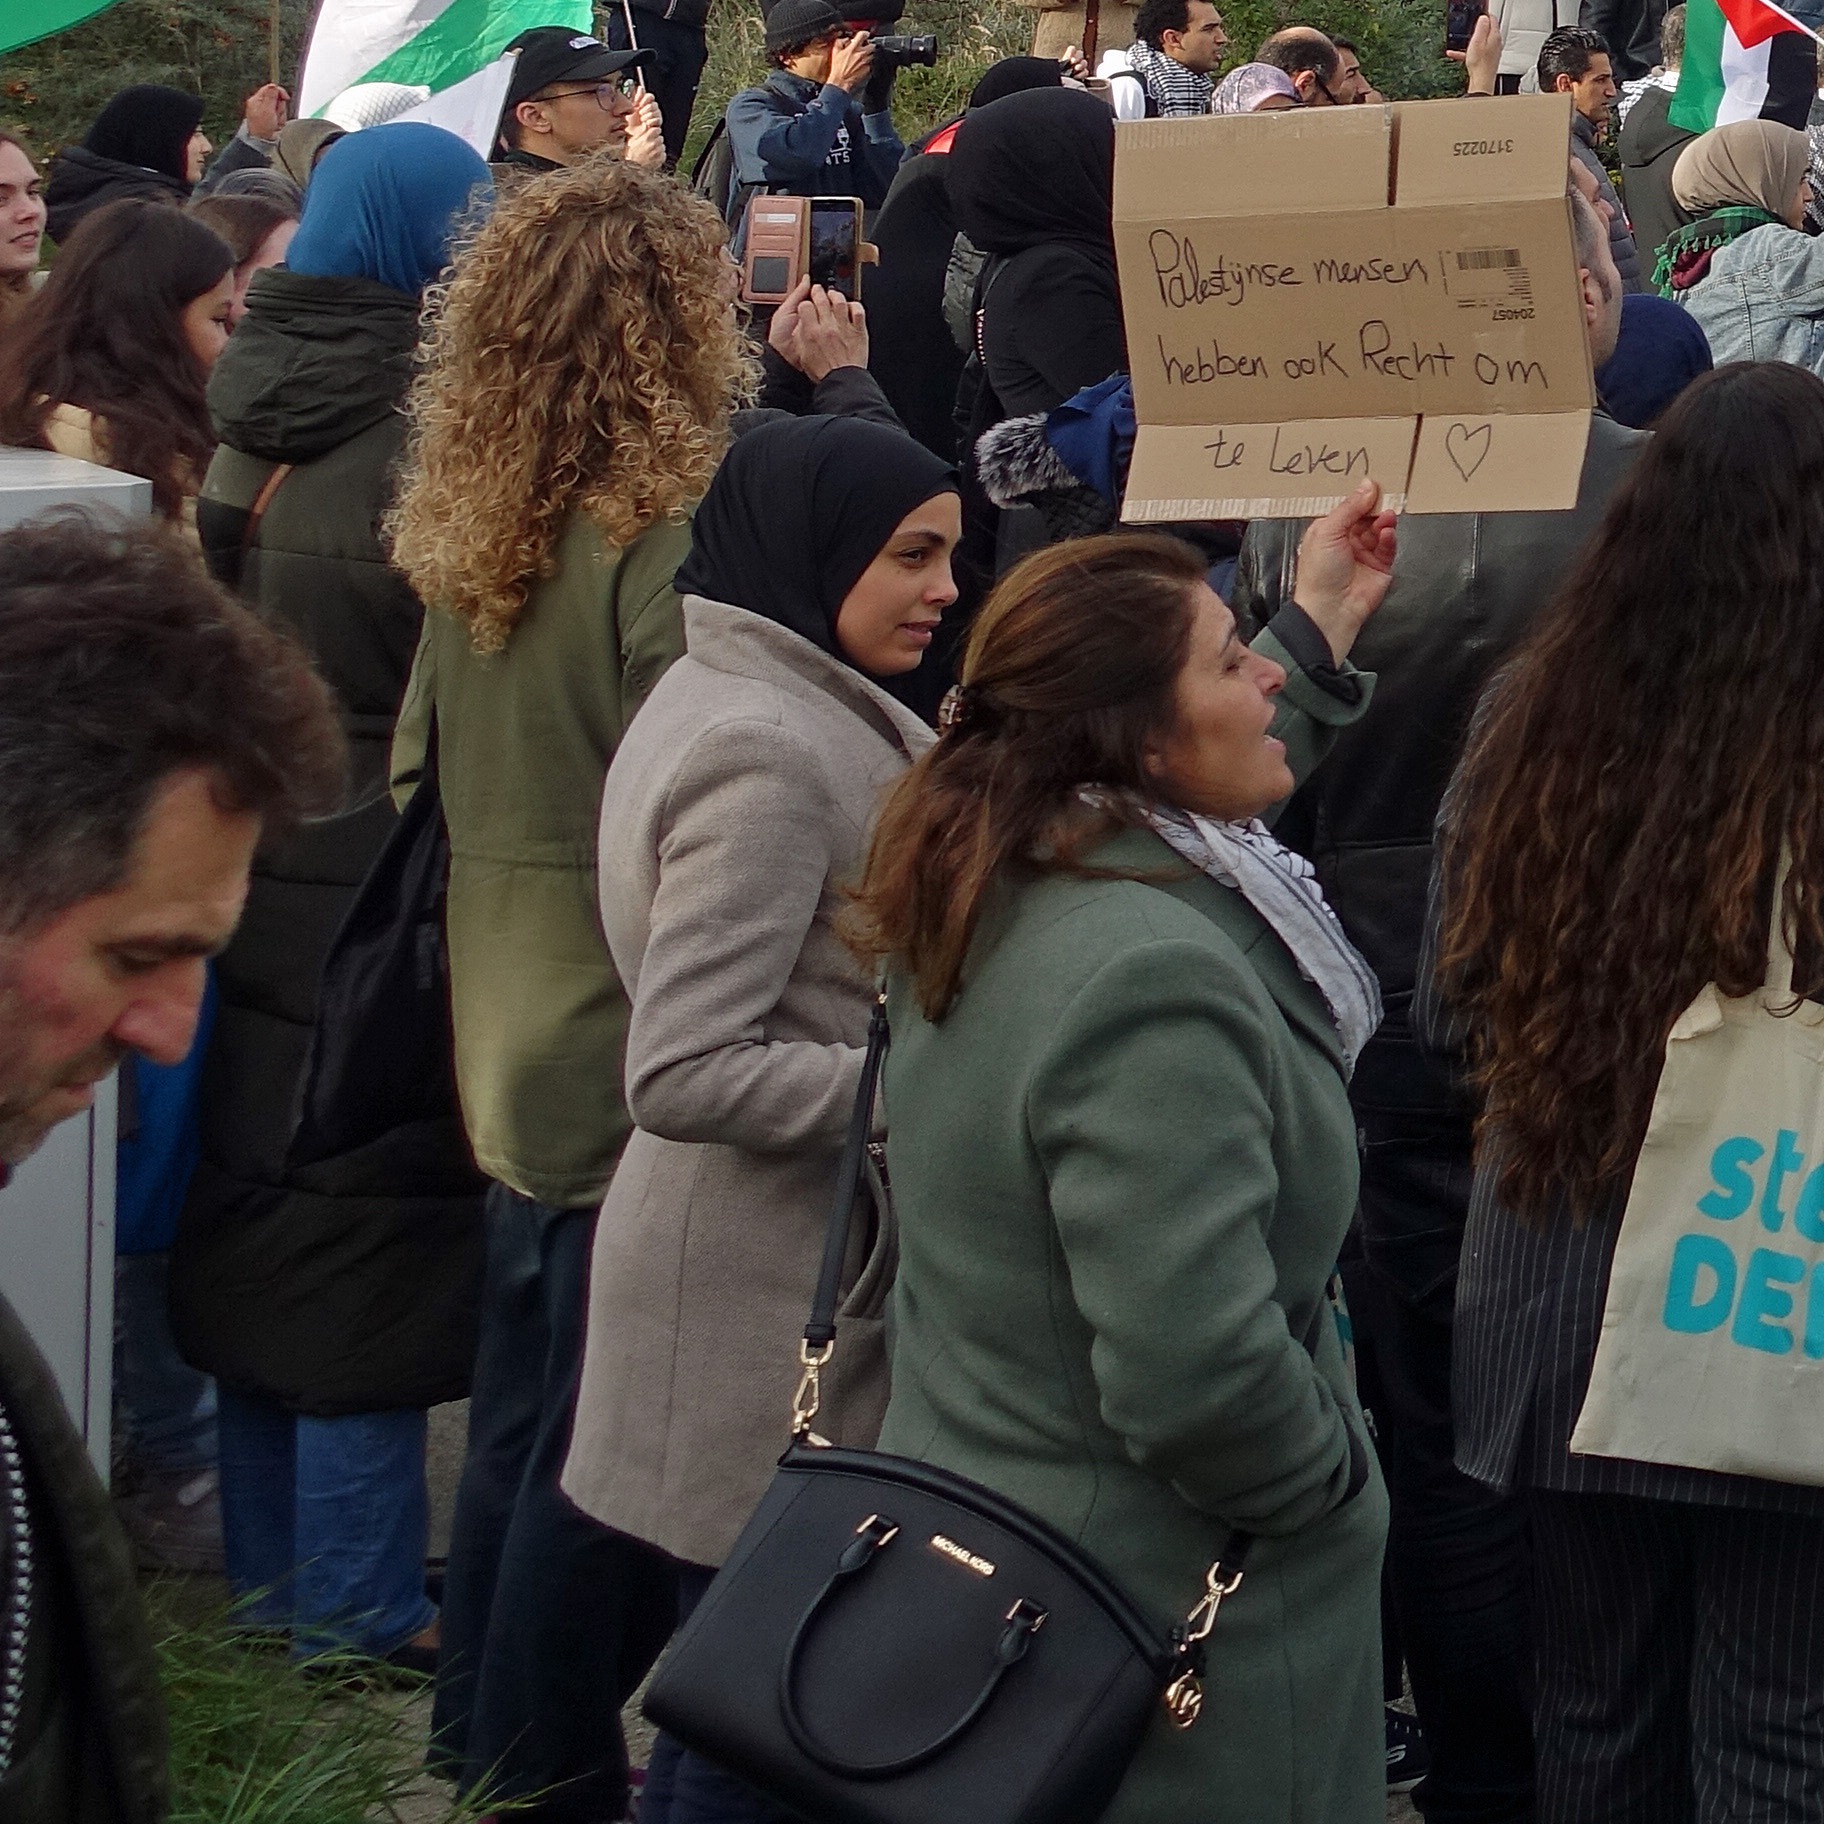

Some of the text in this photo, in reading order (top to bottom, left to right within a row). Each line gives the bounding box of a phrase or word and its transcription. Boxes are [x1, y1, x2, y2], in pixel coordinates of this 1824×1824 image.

[1453, 139, 1514, 156] 3170225
[1313, 257, 1429, 285] mensen
[1492, 307, 1536, 322] 204057
[1157, 333, 1268, 387] hebben
[1359, 318, 1455, 377] Recht
[1474, 350, 1548, 389] om
[1203, 428, 1244, 470] te
[930, 1534, 996, 1575] MICHAEL KORS
